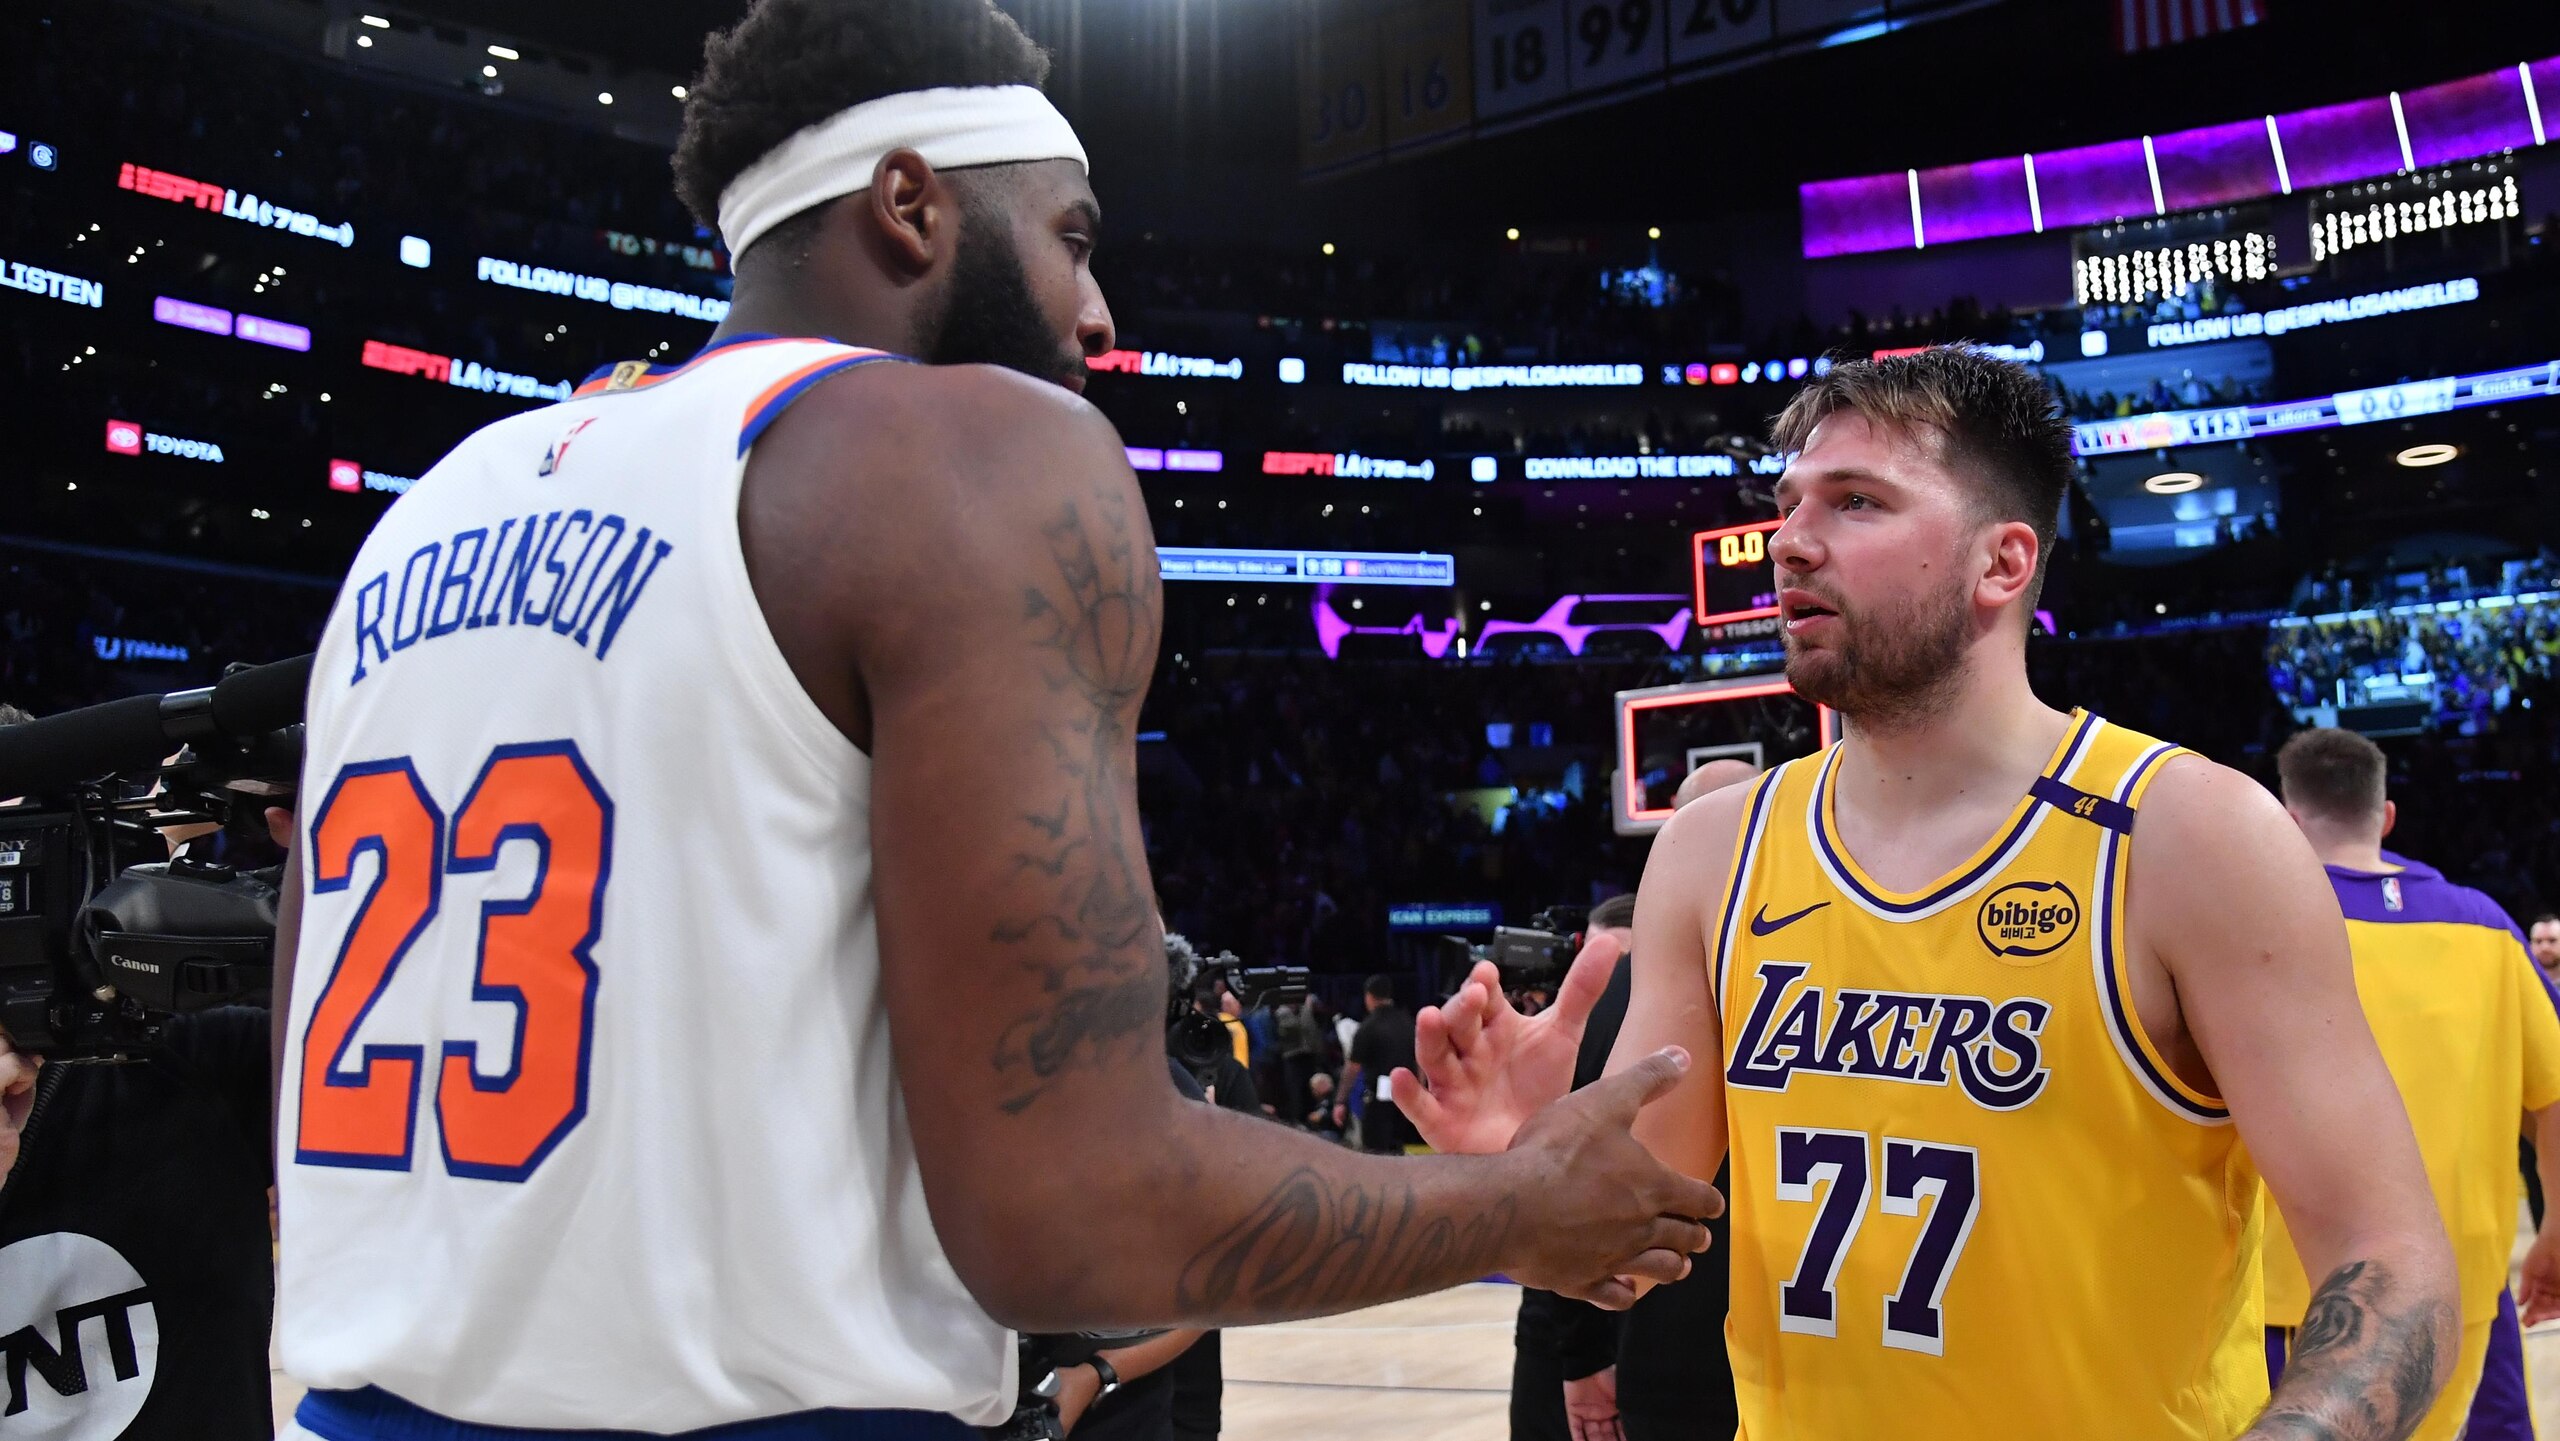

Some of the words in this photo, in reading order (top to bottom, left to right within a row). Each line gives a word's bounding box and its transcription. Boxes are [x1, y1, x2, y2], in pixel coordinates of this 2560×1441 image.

[1578, 0, 1652, 67] 99
[1492, 26, 1546, 91] 18
[0, 258, 103, 308] LISTEN
[478, 256, 574, 295] FOLLOW
[575, 274, 610, 302] US
[2148, 316, 2231, 346] FOLLOW
[2232, 312, 2264, 337] US
[2264, 278, 2478, 335] @ESPNLOSANGELES
[1343, 363, 1421, 387] FOLLOW
[1421, 367, 1451, 388] US
[1451, 364, 1643, 391] @ESPNLOSANGELES
[145, 432, 224, 463] TOYOTA
[1525, 456, 1638, 479] DOWNLOAD
[1637, 456, 1678, 477] THE
[362, 470, 417, 494] TOYO
[1720, 531, 1764, 566] 0.0
[350, 509, 674, 685] ROBINSON
[2073, 796, 2099, 816] 44
[1425, 908, 1491, 925] EXPRESS
[1987, 901, 2073, 933] bibigo
[2000, 926, 2036, 940] 비비고
[110, 954, 160, 974] Canon
[294, 738, 615, 1183] 23
[1726, 960, 2054, 1112] LAKERS
[1775, 1126, 1980, 1357] 77
[0, 1286, 152, 1416] NT
